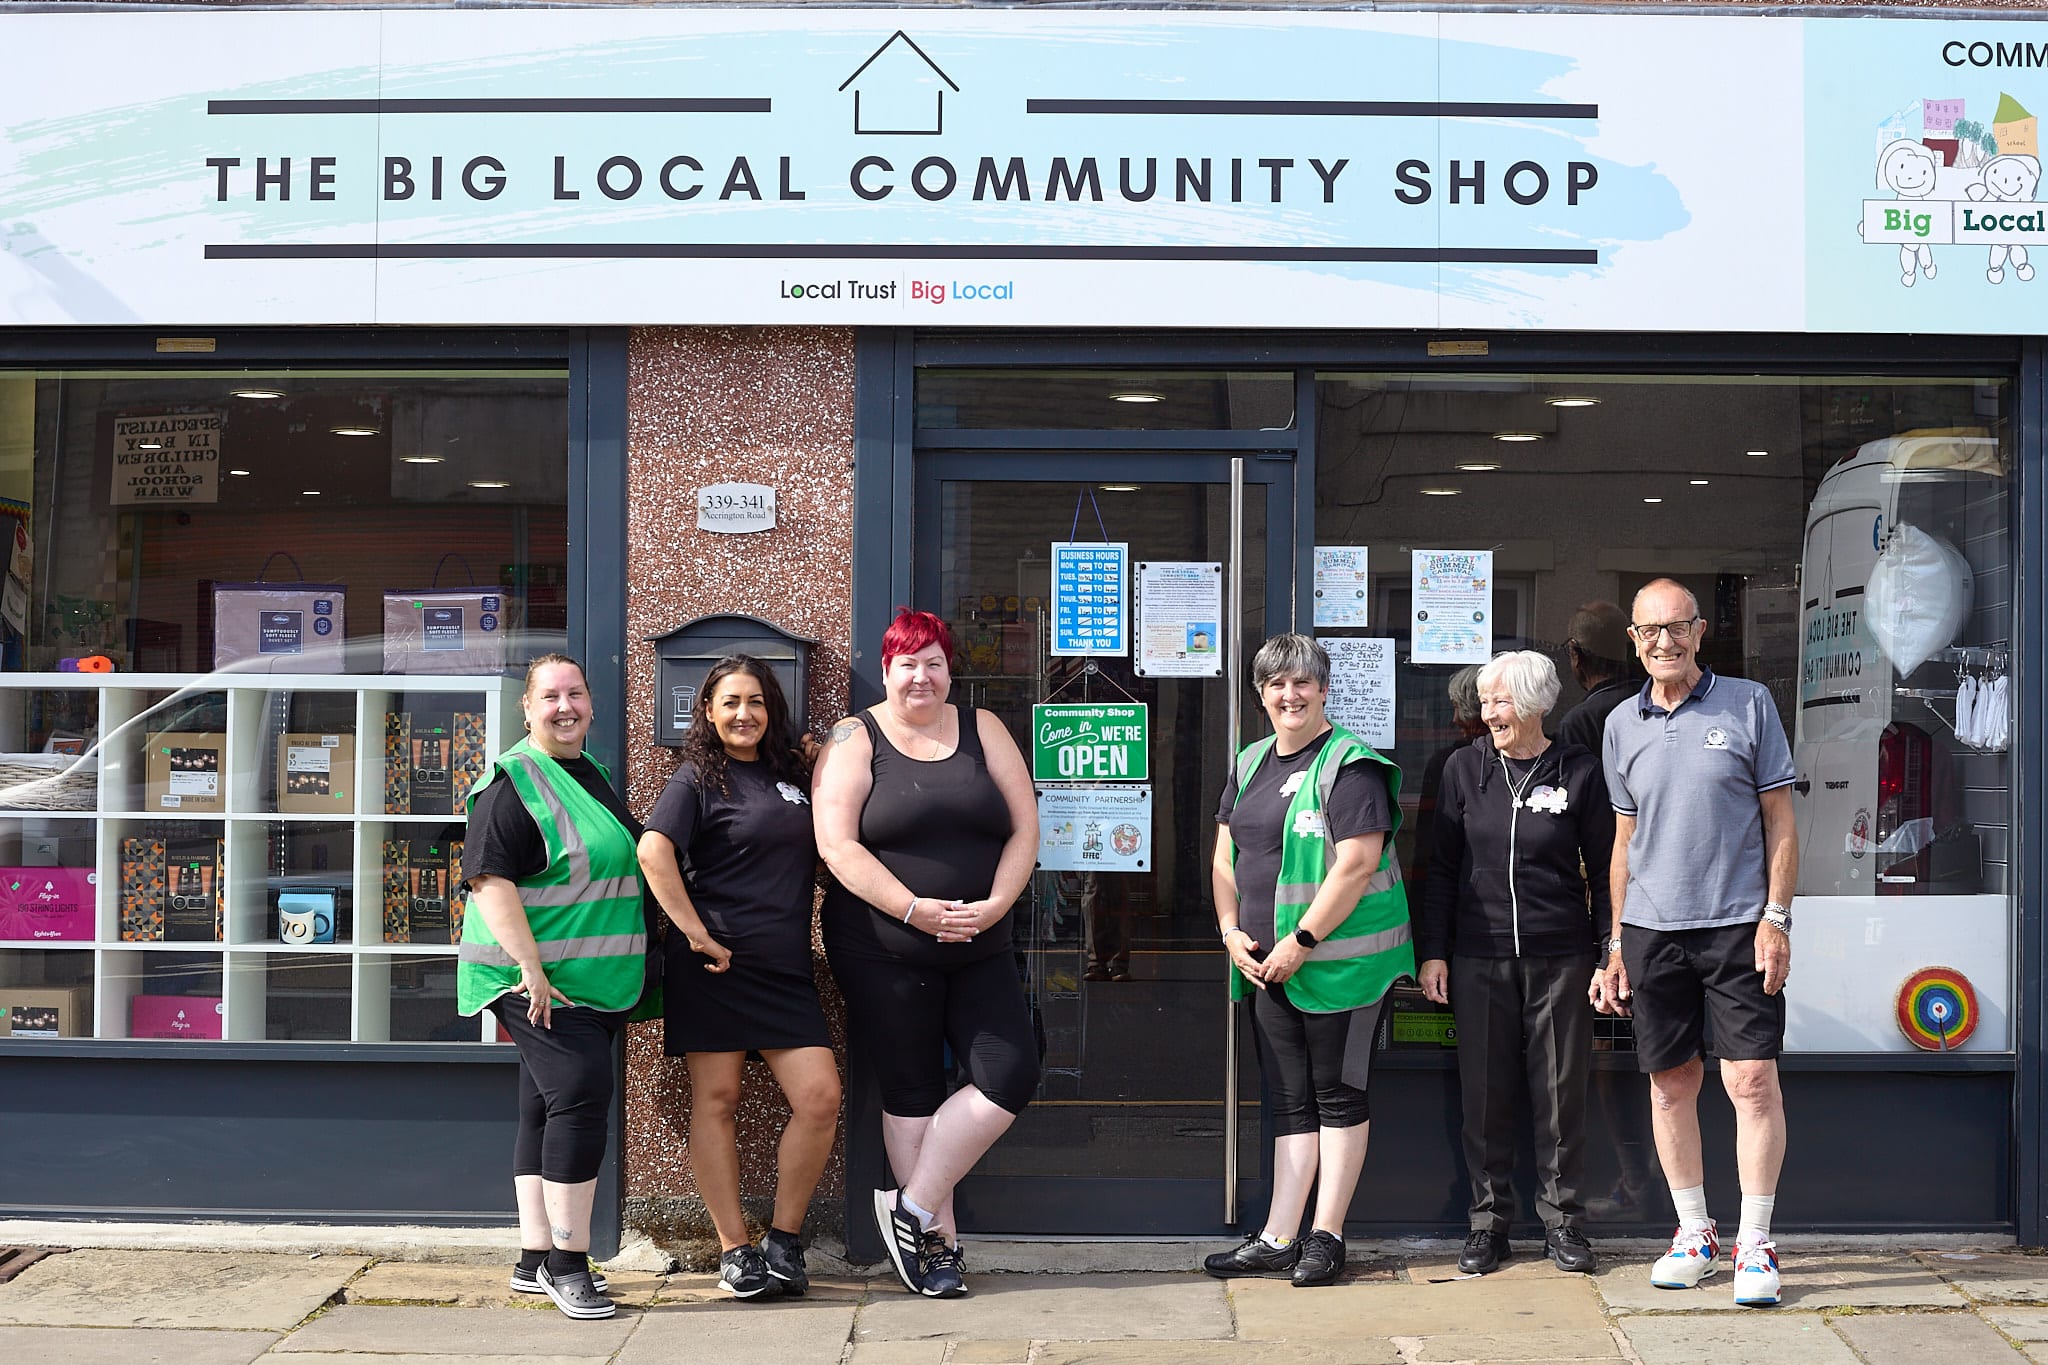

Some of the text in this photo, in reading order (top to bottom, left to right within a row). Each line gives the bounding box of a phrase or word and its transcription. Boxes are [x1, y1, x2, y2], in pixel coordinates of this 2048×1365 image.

[207, 155, 1599, 206] THE BIG LOCAL COMMUNITY SHOP
[1884, 209, 2045, 237] Big Local
[782, 281, 1013, 304] Local Trust Big Local
[705, 495, 764, 509] 339-341
[704, 512, 744, 521] Accrington
[1061, 552, 1119, 560] BUSINESS HOURS
[1430, 562, 1474, 571] SUMMER
[1432, 568, 1472, 576] CARNIVAL
[1069, 639, 1111, 647] THANK YOU
[1341, 642, 1382, 650] OSWALDS
[1045, 708, 1135, 718] Community Shop
[1040, 721, 1092, 744] Come in
[1101, 726, 1142, 741] WE'RE
[1058, 745, 1127, 776] OPEN
[1046, 795, 1145, 804] COMMUNITY PARTNERSHIP
[39, 892, 60, 901] Plug-in
[30, 904, 54, 912] STRING
[55, 904, 78, 912] LIGHTS
[171, 1021, 190, 1030] Plug-in
[1448, 1029, 1454, 1038] 5
